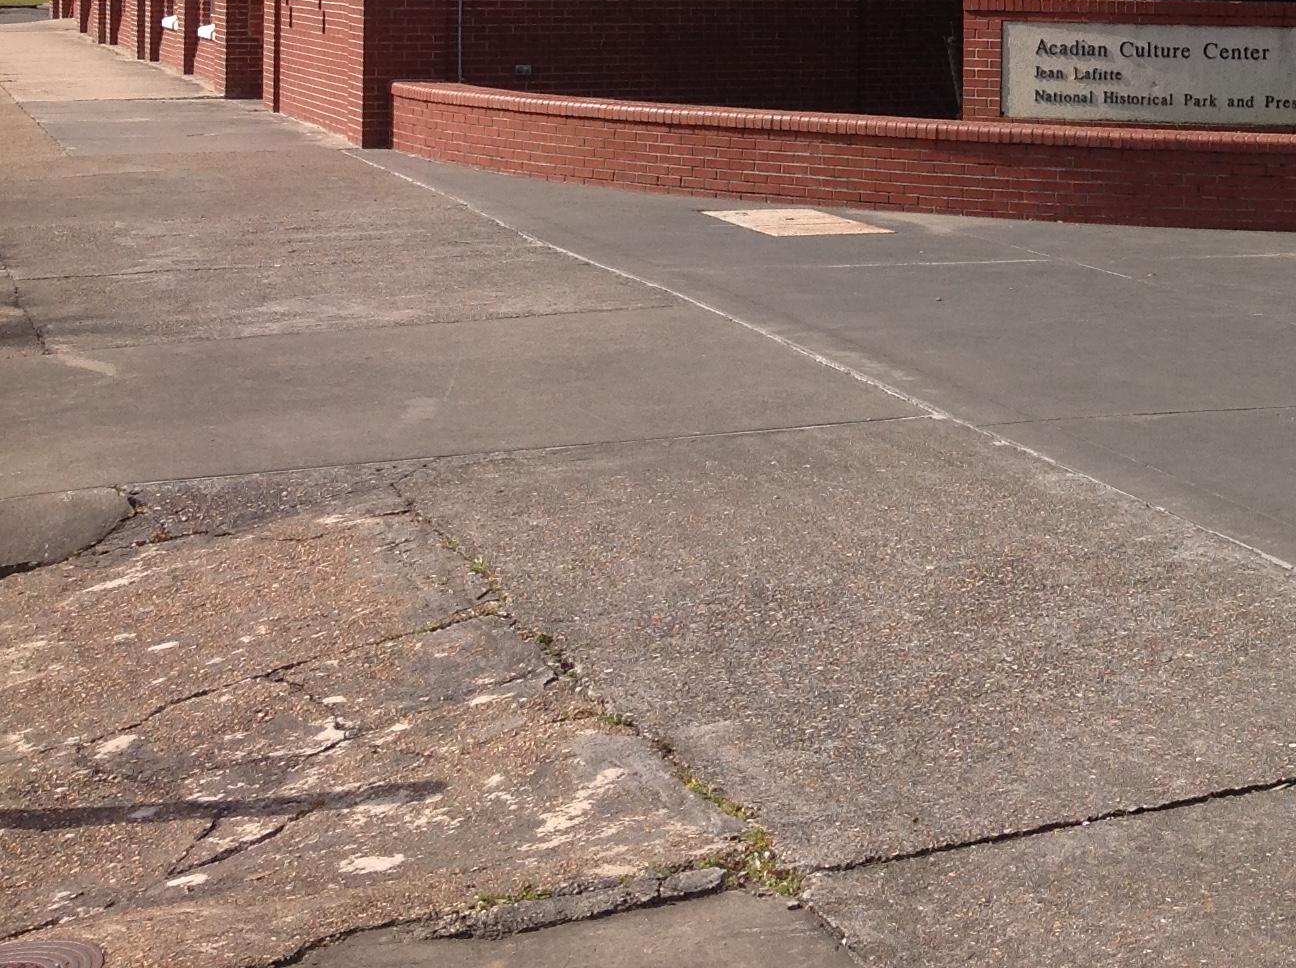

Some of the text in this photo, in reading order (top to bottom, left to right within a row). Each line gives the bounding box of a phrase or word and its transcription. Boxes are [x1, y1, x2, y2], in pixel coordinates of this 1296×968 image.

[1035, 38, 1270, 61] Acadian Culture Center
[1034, 65, 1123, 81] Jean Lafitte
[1034, 89, 1093, 105] National
[1103, 91, 1174, 107] Historical
[1183, 93, 1217, 109] Park
[1227, 95, 1255, 109] and
